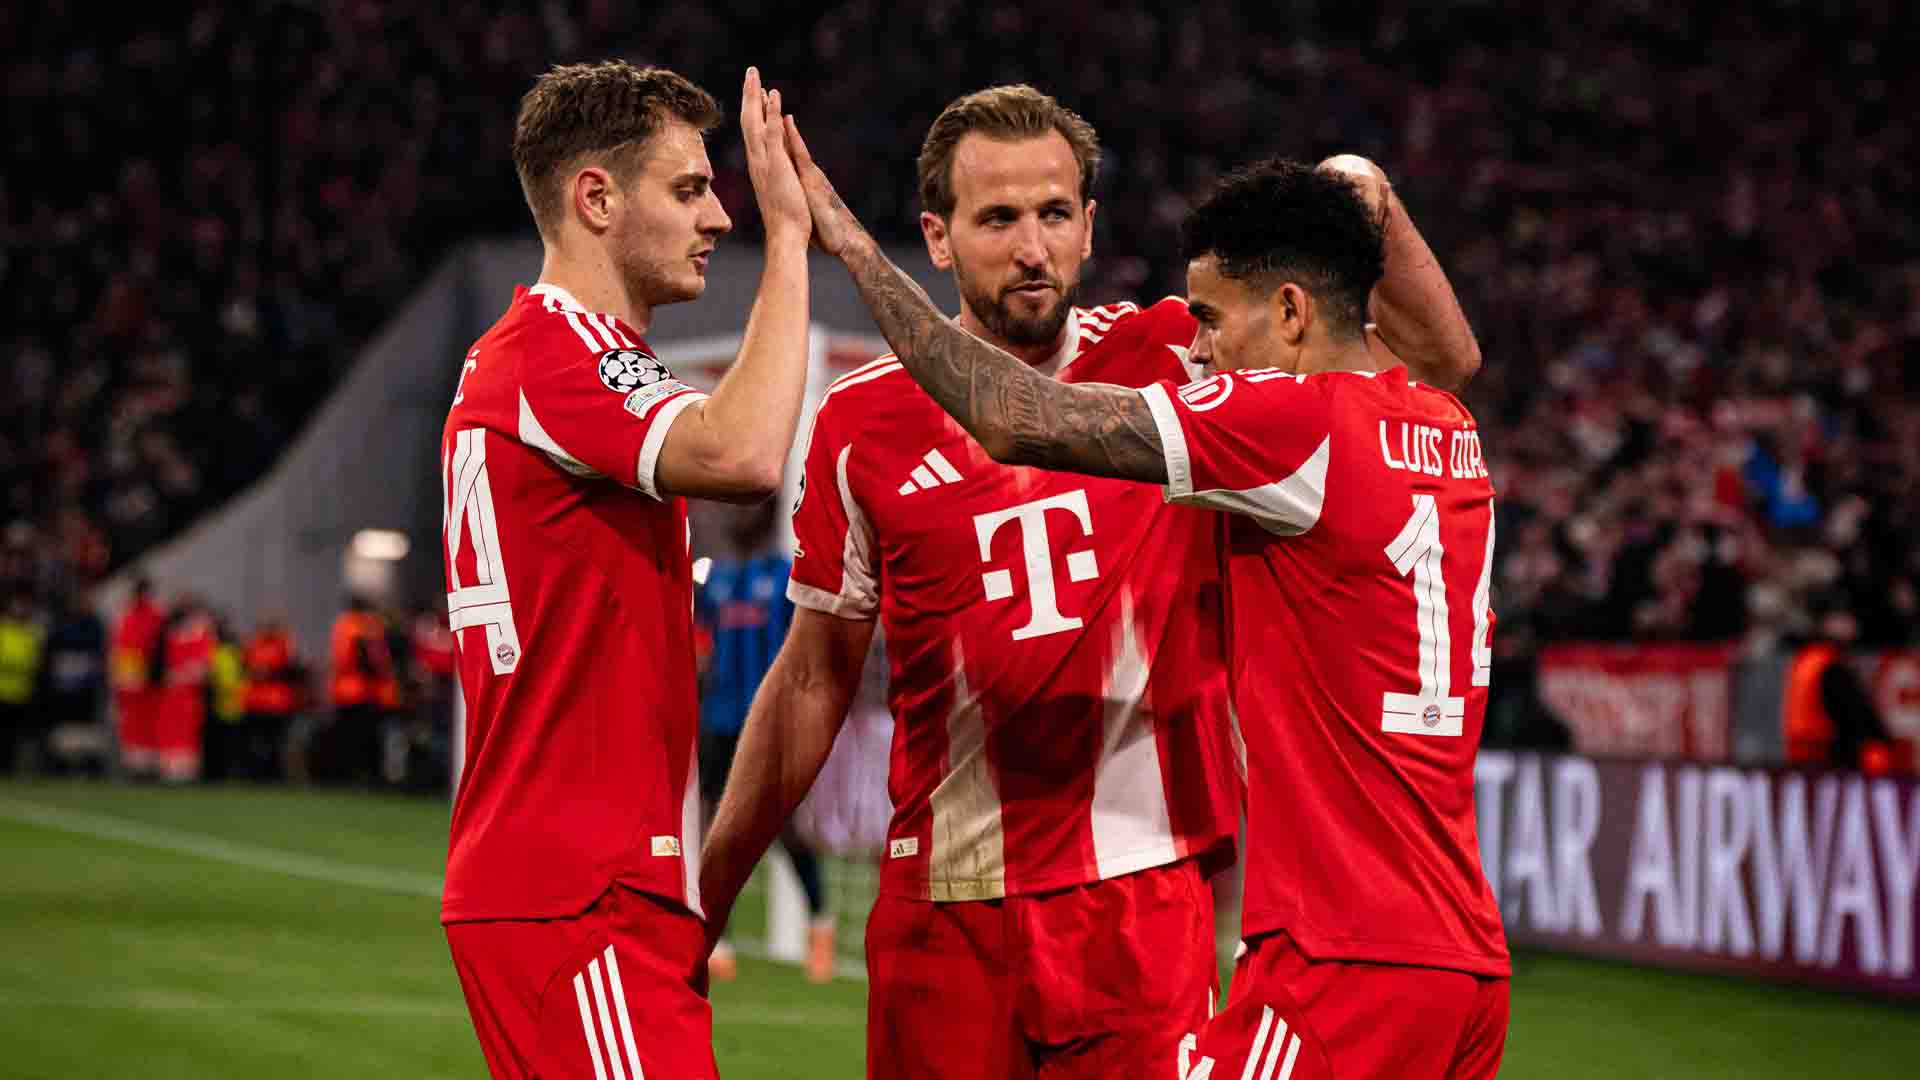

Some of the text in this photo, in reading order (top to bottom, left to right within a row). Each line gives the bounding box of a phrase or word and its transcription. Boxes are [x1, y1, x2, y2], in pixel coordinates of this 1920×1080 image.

[1379, 420, 1443, 477] LUIS
[444, 428, 522, 676] 4
[972, 489, 1100, 641] T
